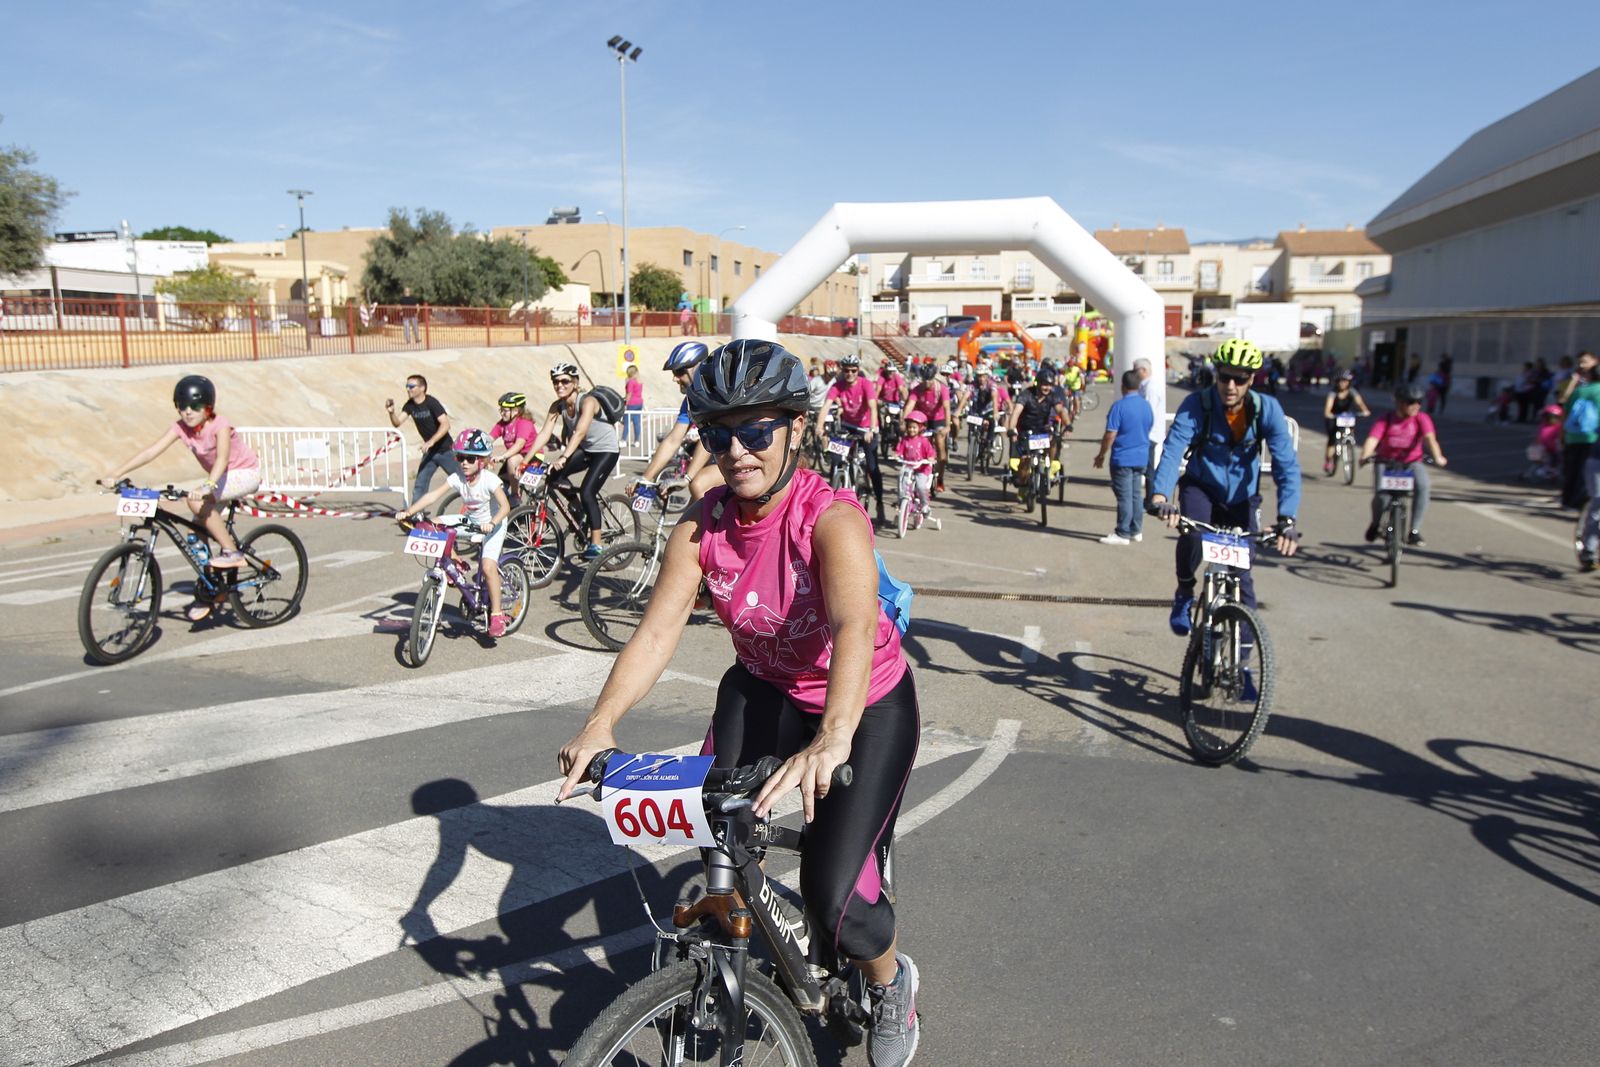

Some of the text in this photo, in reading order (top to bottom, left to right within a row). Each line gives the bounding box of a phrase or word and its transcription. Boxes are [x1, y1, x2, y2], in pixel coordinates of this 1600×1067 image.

[523, 475, 538, 485] 628
[122, 501, 150, 514] 632
[634, 497, 649, 511] 631
[410, 541, 439, 554] 630
[1209, 546, 1240, 563] 591
[659, 773, 679, 781] ALMERÍA
[614, 797, 694, 839] 604
